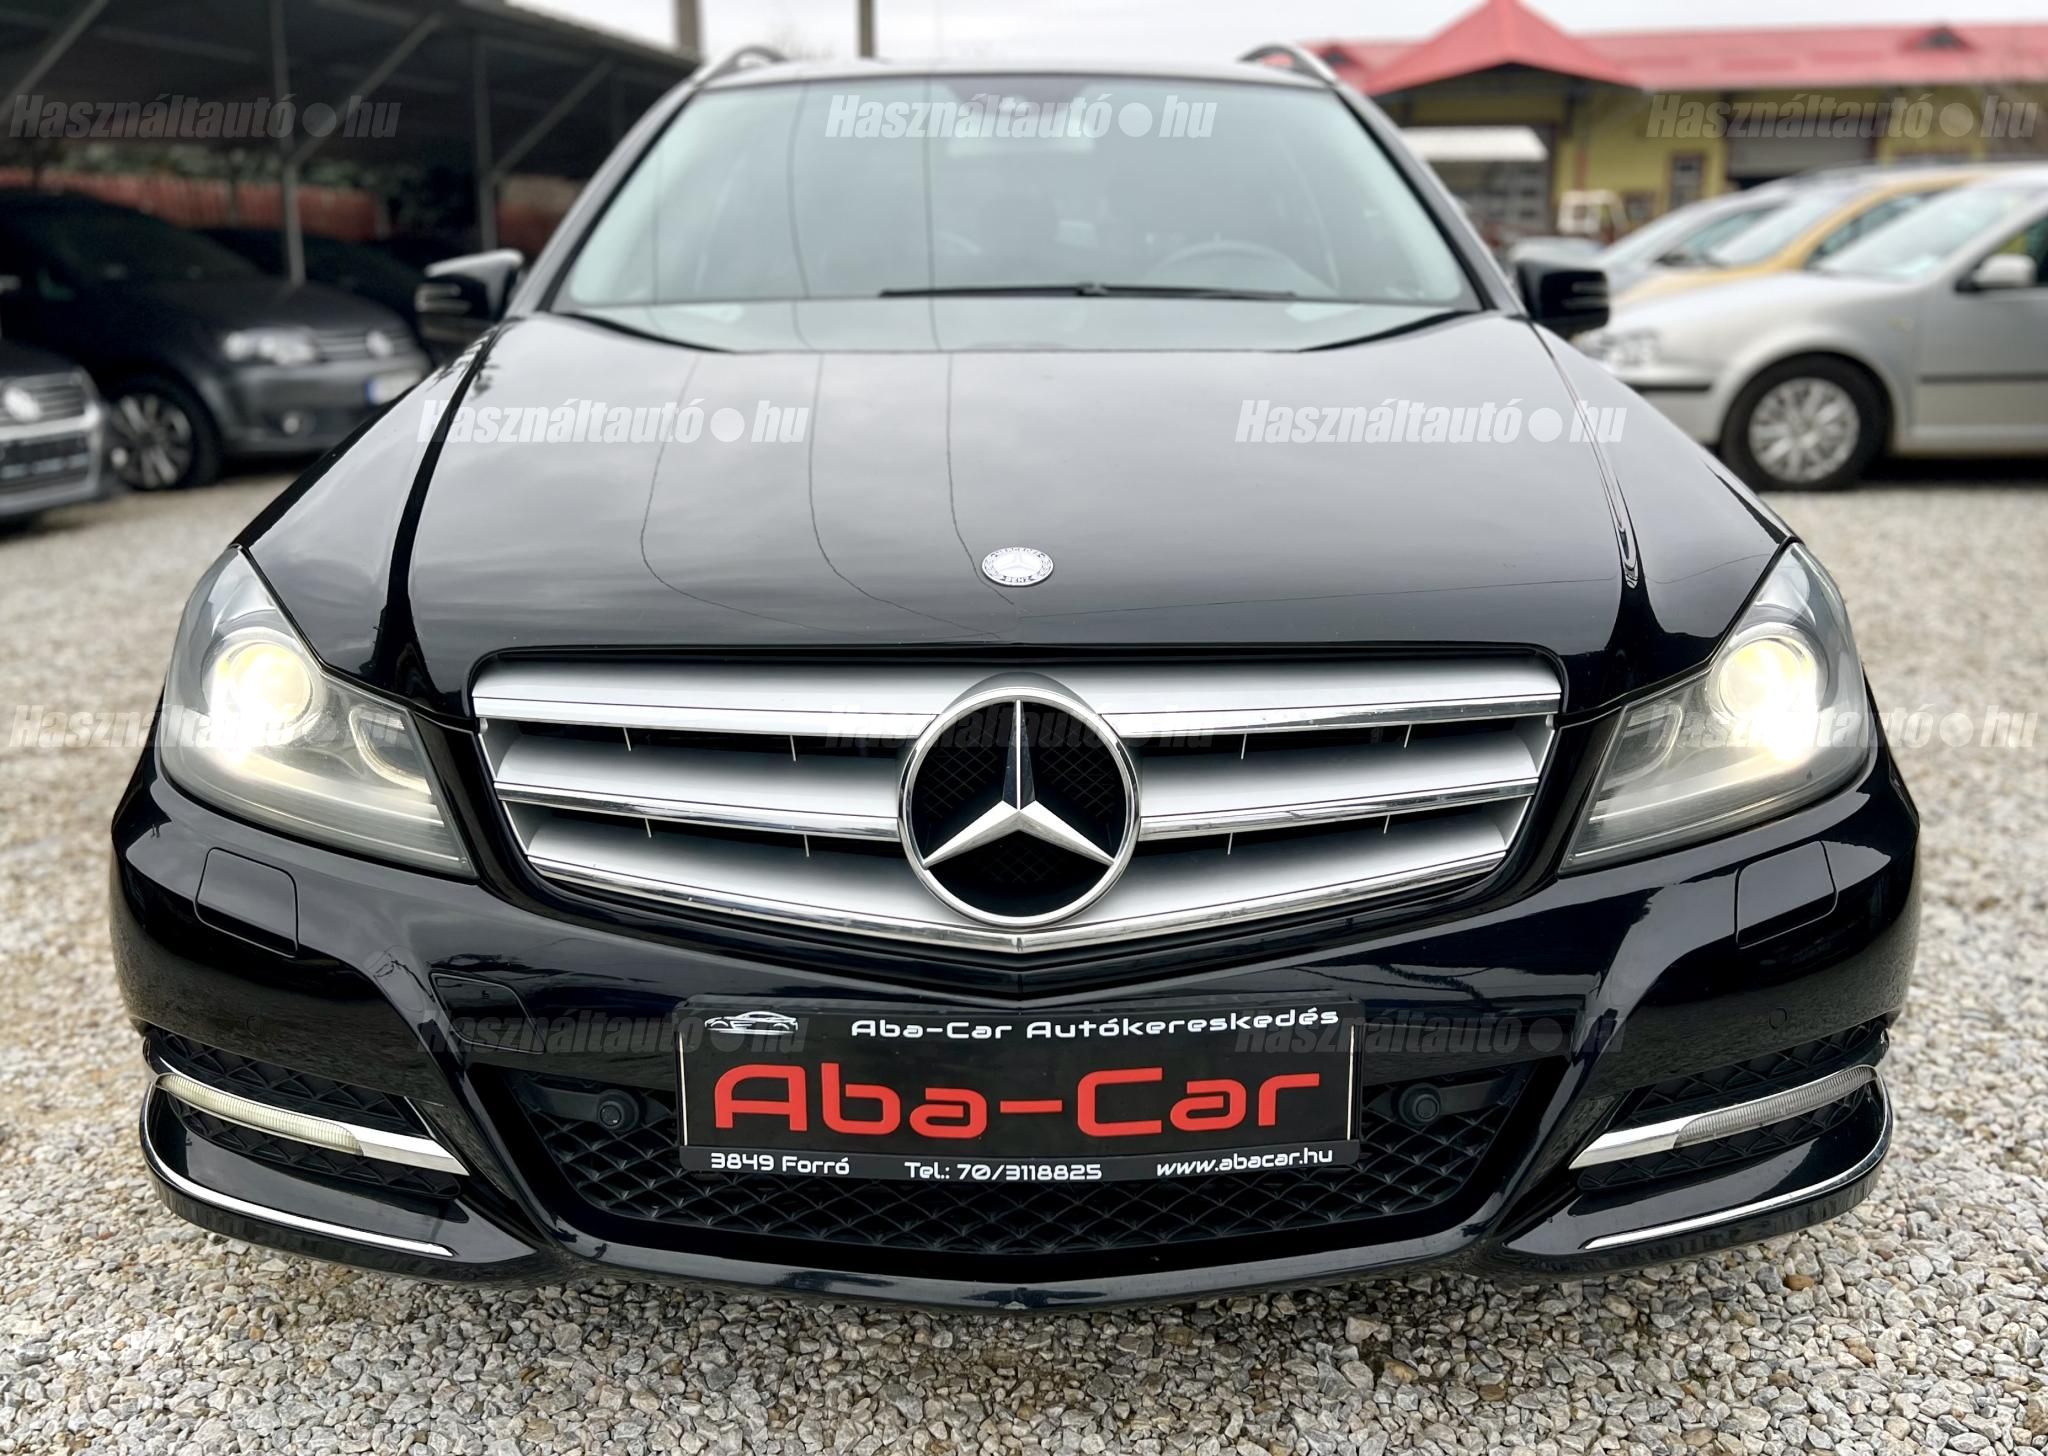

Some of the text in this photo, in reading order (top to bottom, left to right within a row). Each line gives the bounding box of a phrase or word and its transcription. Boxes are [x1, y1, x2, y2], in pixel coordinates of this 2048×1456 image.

[851, 1007, 1339, 1039] Aba-Car Autókereskedés
[714, 1062, 1320, 1139] Aba-Car
[710, 1152, 850, 1175] 3849 Forró
[904, 1161, 1103, 1181] Tel.: 70/3118825
[1156, 1147, 1333, 1177] www.abacar.hu
